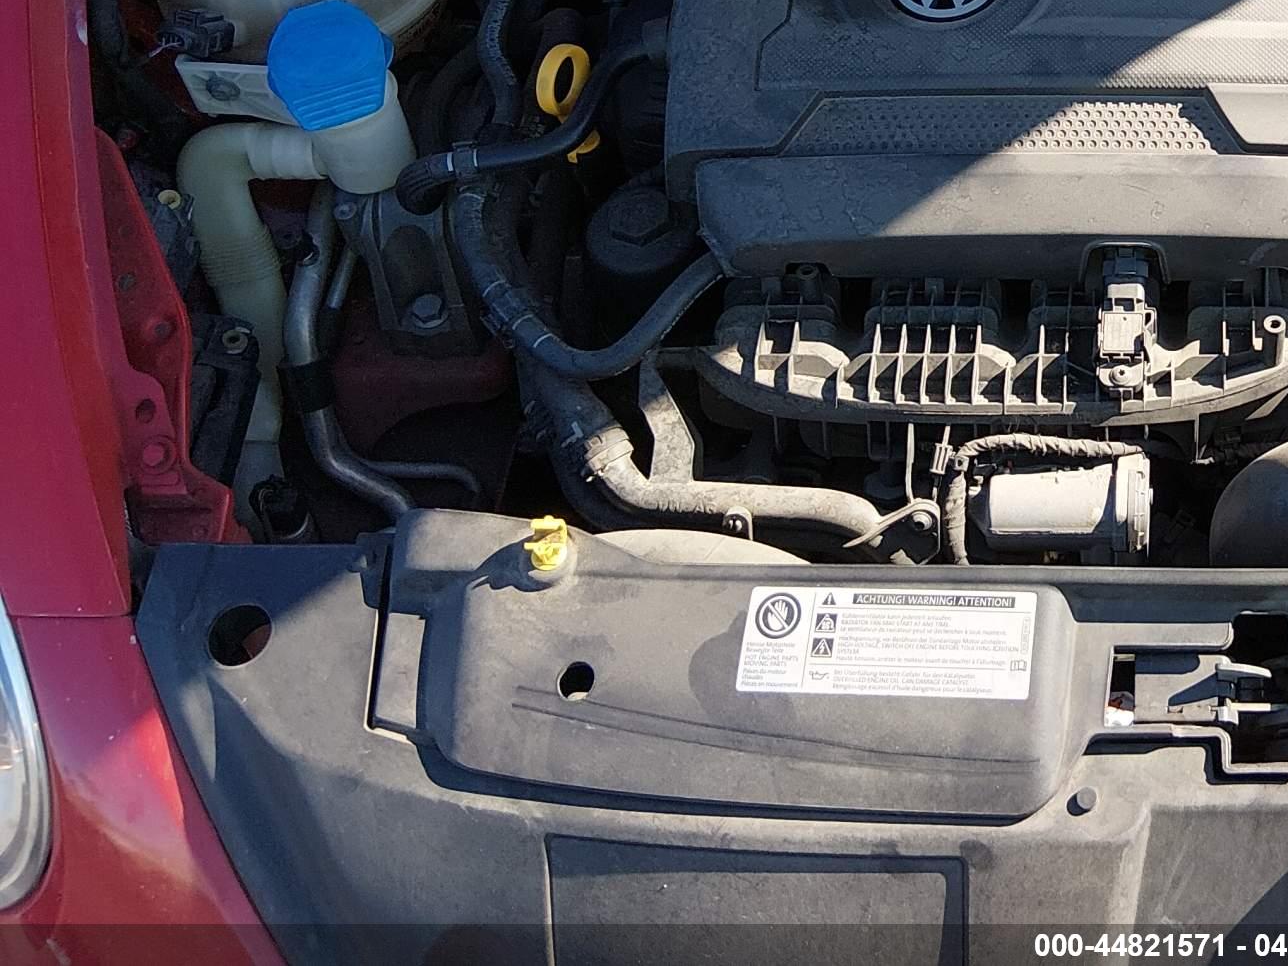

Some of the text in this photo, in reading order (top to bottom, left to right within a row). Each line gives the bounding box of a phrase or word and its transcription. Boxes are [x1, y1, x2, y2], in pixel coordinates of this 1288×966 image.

[856, 595, 1012, 607] ACHTUNG! WARNING! ATTENTION!
